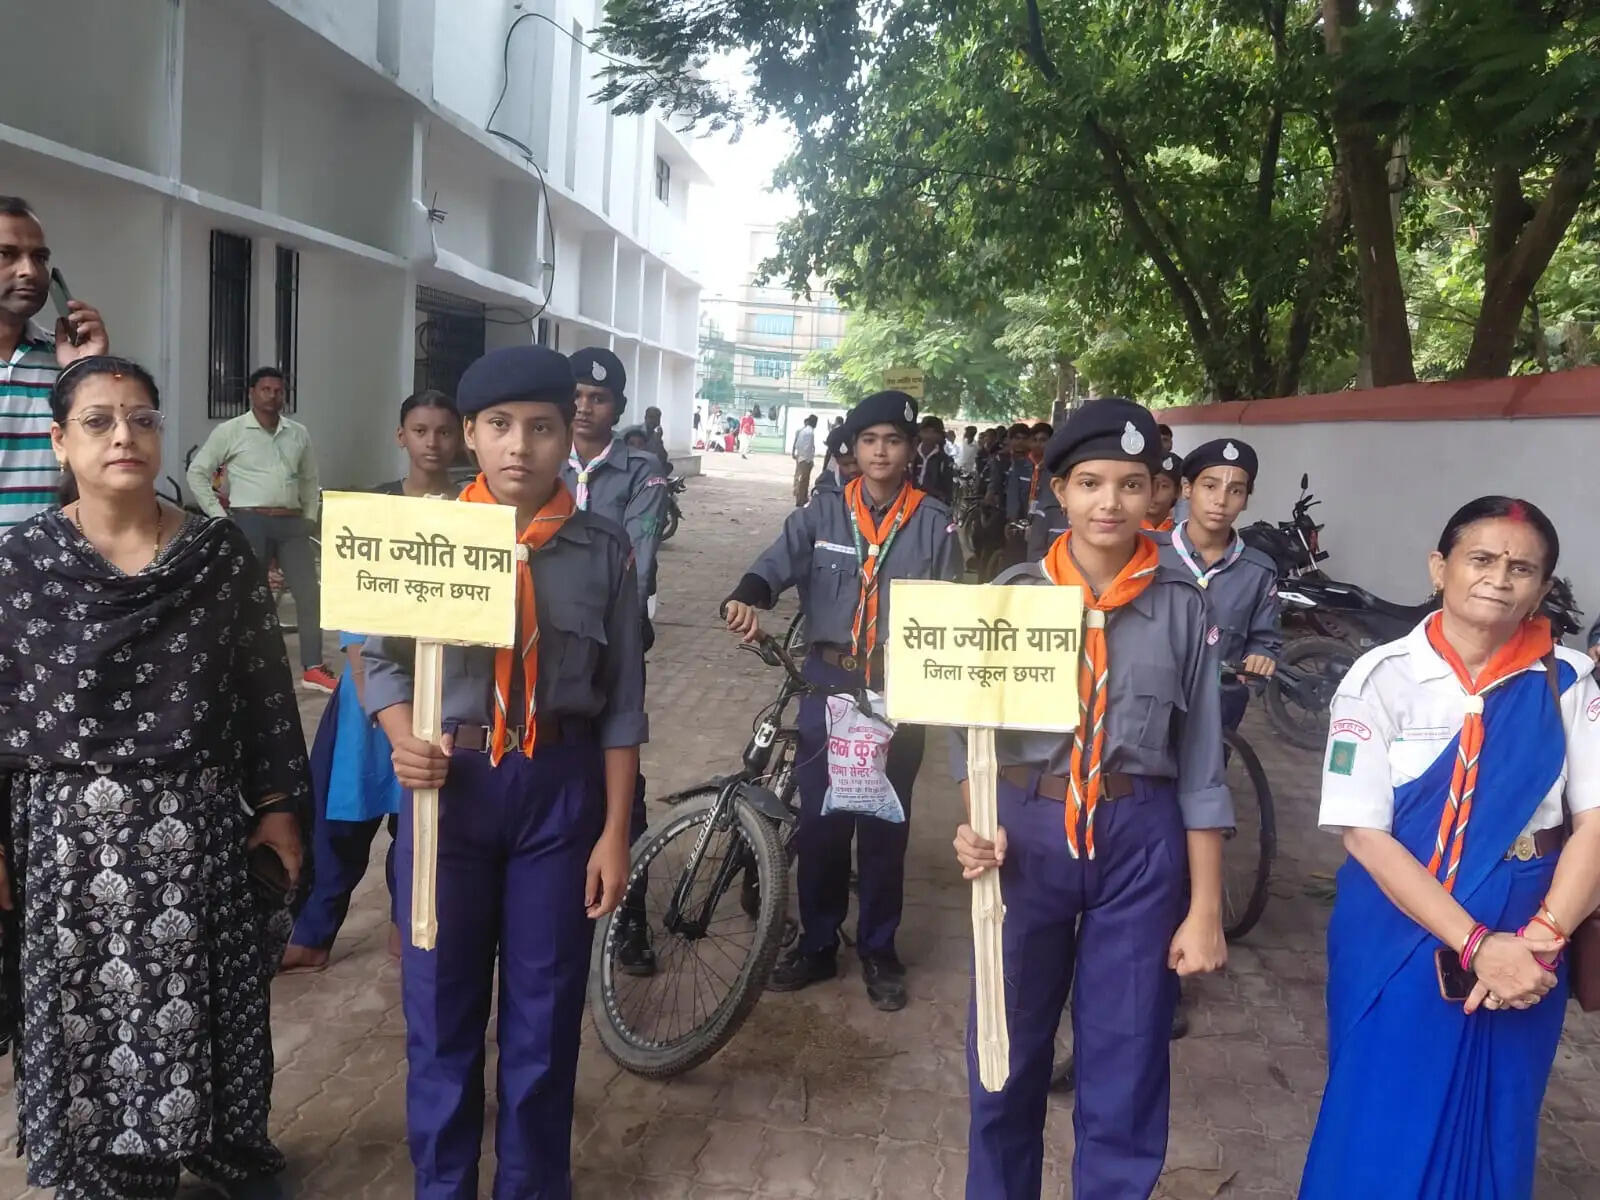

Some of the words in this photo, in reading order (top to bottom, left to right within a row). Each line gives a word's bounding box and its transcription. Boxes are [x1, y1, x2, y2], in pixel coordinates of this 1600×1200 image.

[335, 525, 382, 562] सेवा
[390, 532, 457, 568] ज्योति
[463, 545, 512, 573] यात्रा
[356, 569, 399, 594] जिला
[404, 578, 444, 603] स्कूल
[449, 583, 491, 602] छपरा
[902, 617, 947, 650] सेवा
[953, 618, 1019, 651] ज्योति
[1026, 628, 1077, 652] यात्रा
[922, 658, 962, 681] जिला
[967, 665, 1007, 688] स्कूल
[1013, 667, 1056, 683] छपरा
